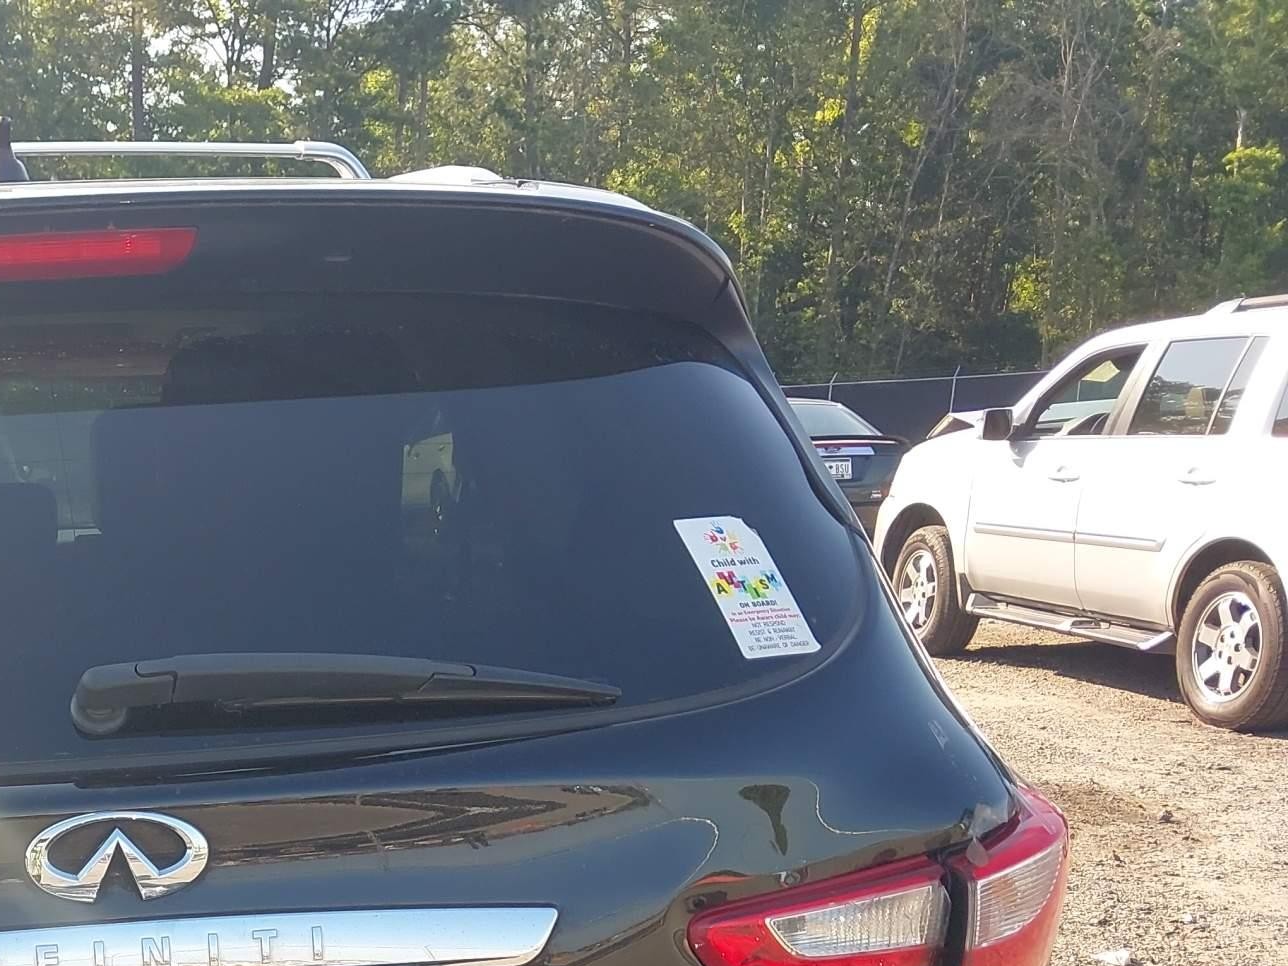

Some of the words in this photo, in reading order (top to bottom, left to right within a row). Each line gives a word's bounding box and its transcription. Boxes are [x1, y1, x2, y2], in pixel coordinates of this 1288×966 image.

[710, 558, 737, 568] Child
[738, 556, 760, 567] with
[715, 570, 779, 598] AUTISM
